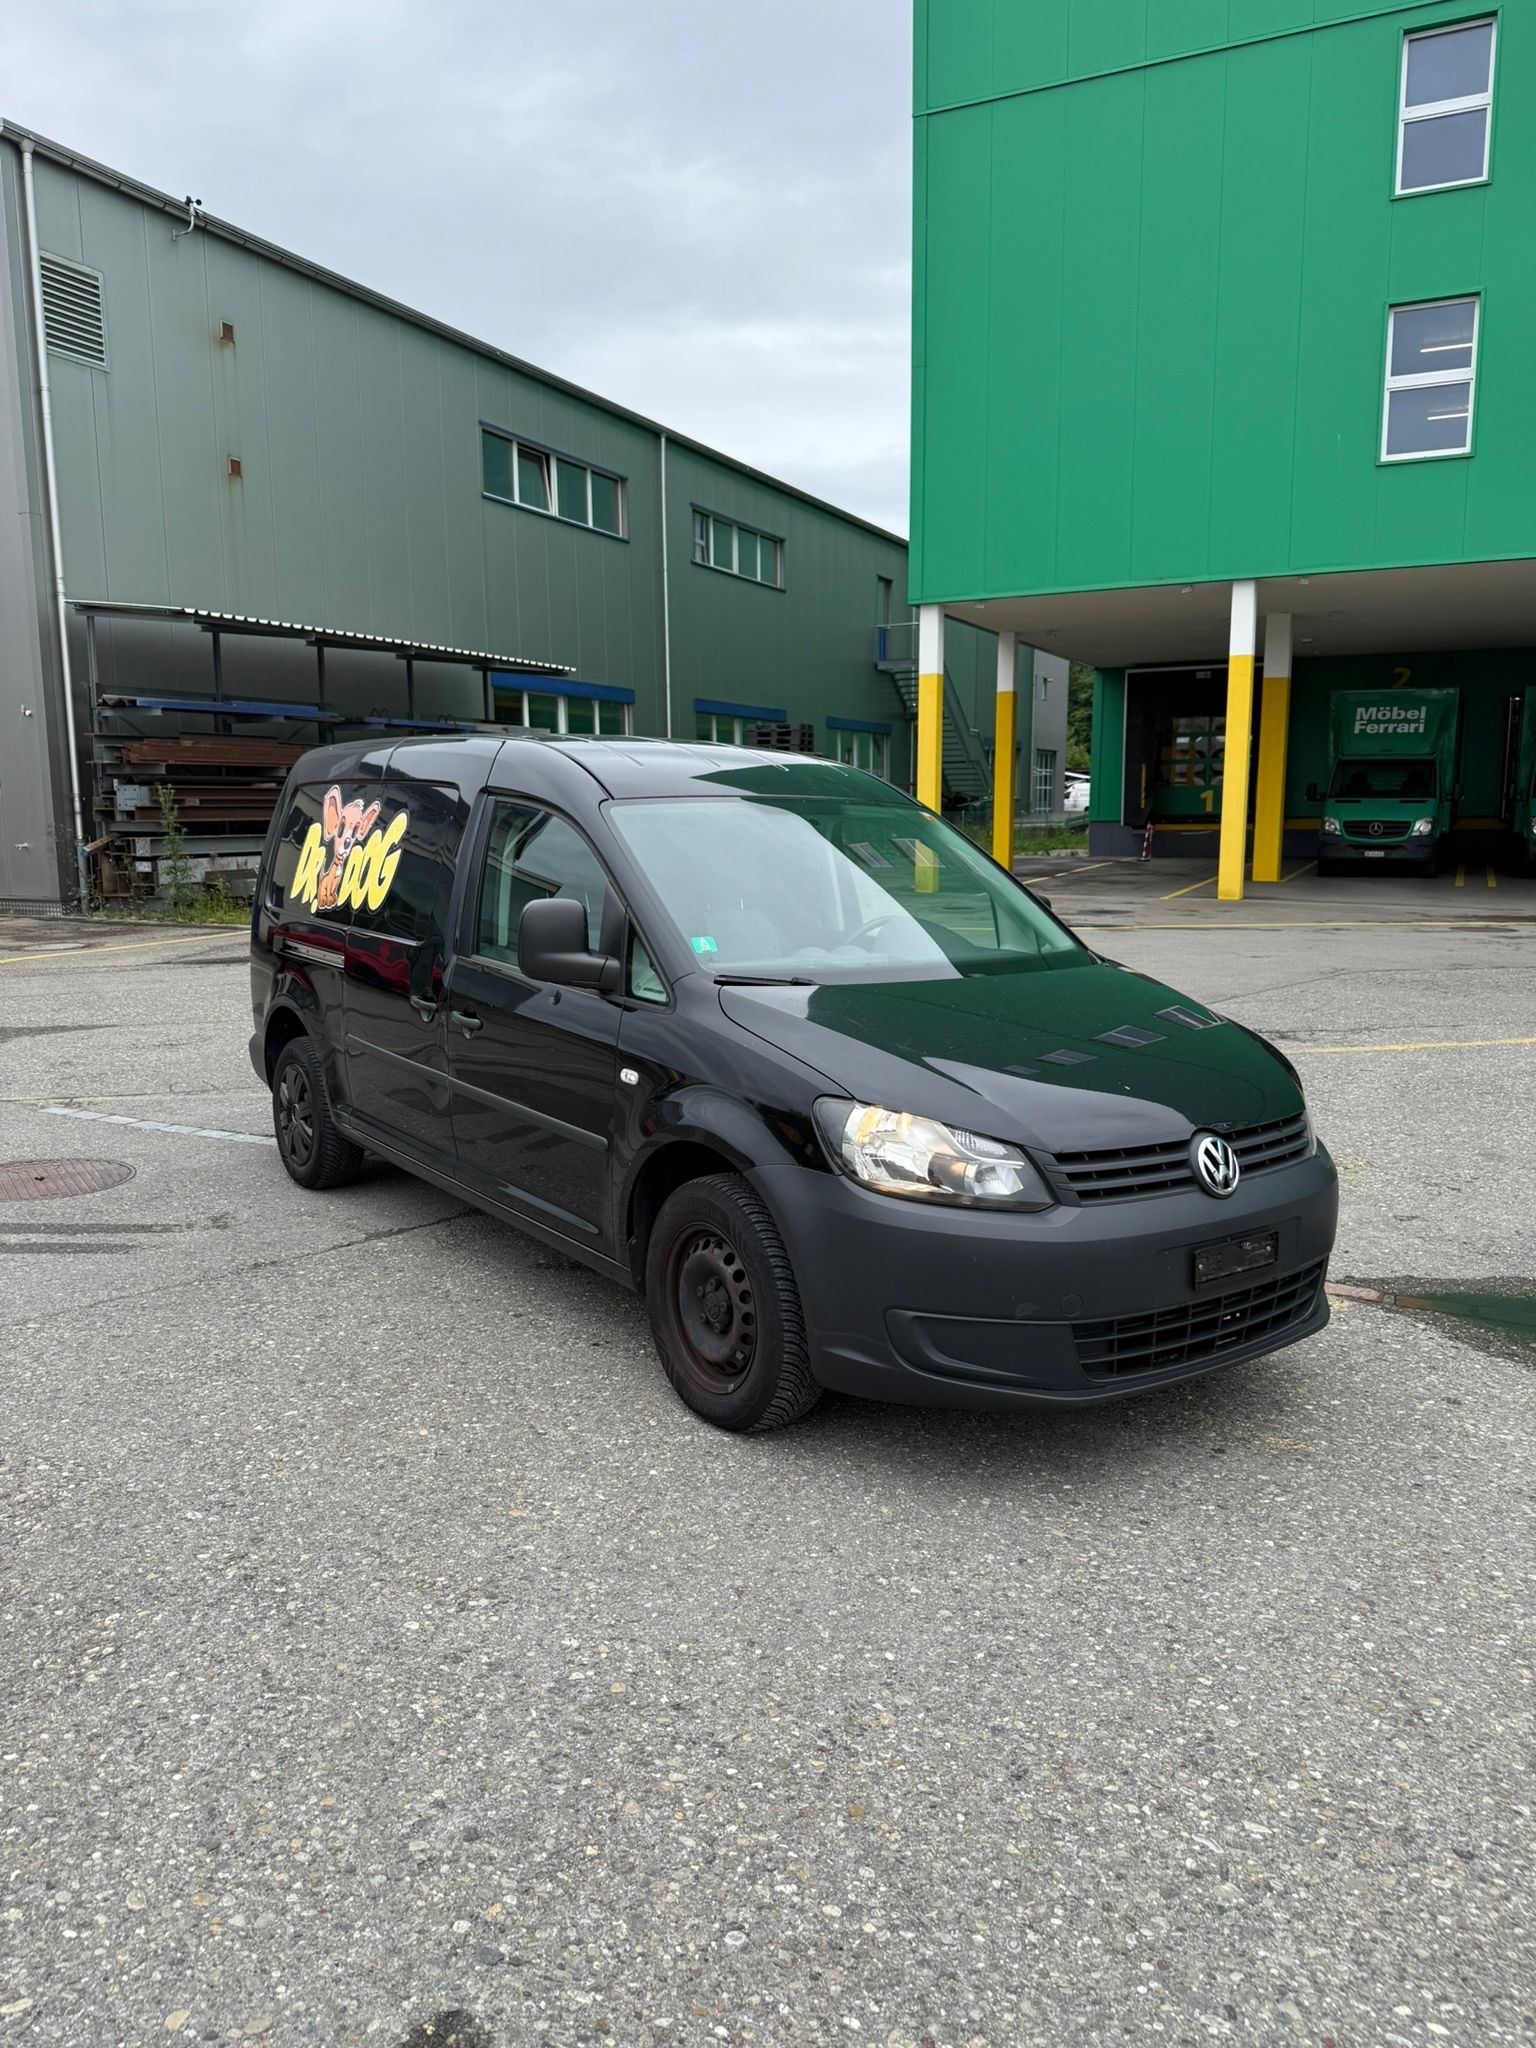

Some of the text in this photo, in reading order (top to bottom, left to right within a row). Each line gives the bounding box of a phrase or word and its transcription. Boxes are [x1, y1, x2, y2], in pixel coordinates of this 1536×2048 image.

[1393, 668, 1411, 688] 2
[1356, 706, 1427, 721] Möbel
[1353, 720, 1425, 734] Ferrari
[1200, 790, 1214, 812] 1
[337, 812, 408, 911] DOG
[1198, 1136, 1240, 1195] VW
